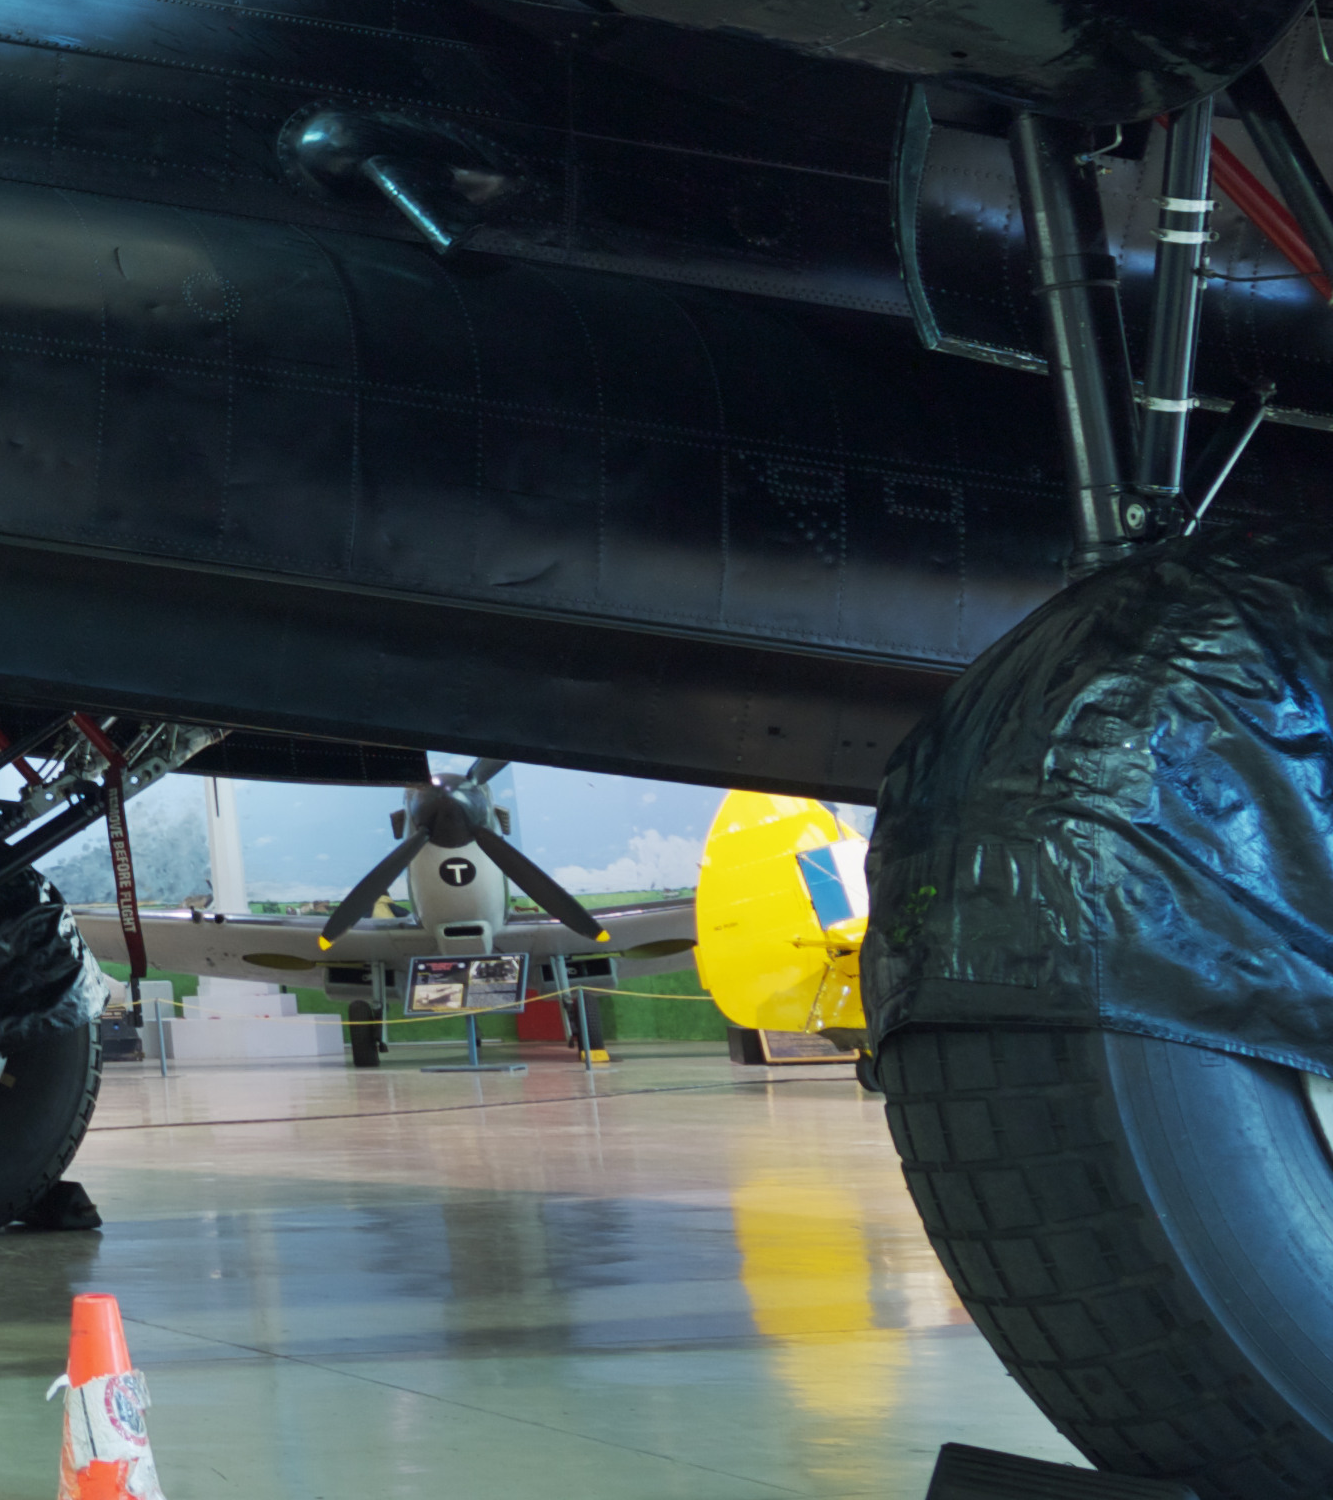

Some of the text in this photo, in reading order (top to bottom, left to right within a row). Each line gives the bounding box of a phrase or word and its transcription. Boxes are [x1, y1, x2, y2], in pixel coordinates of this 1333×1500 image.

[108, 787, 137, 933] REMOVE BEFORE FLIGHT
[447, 864, 468, 884] T
